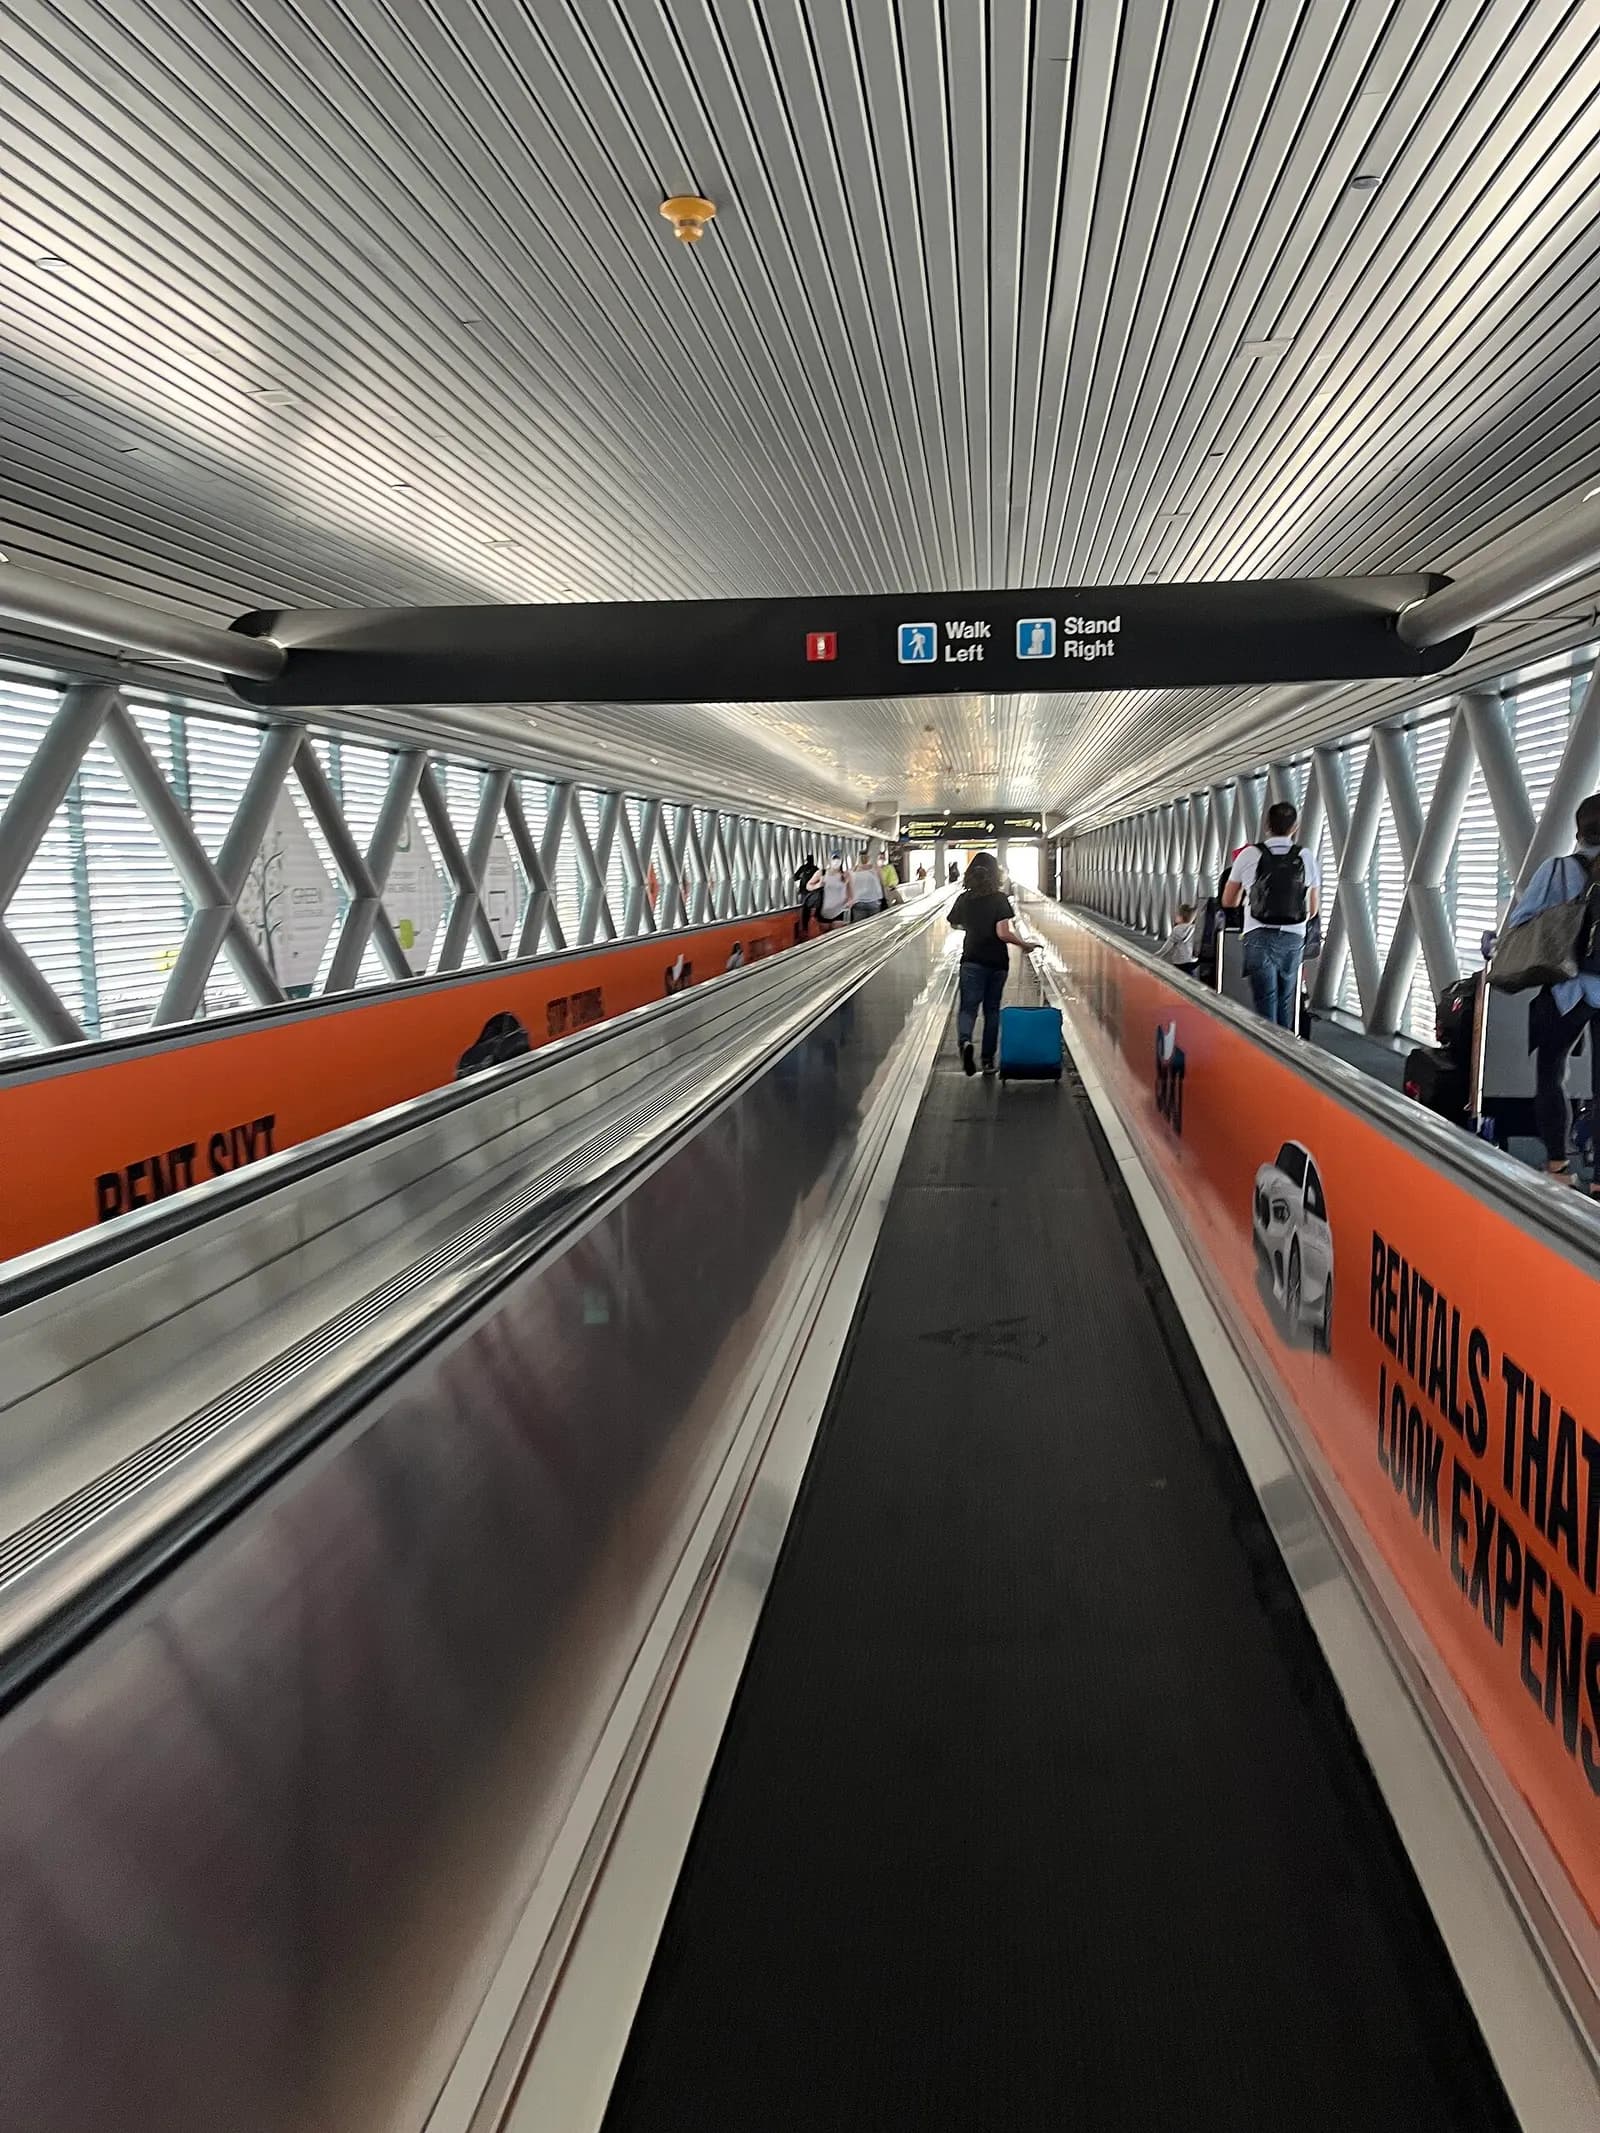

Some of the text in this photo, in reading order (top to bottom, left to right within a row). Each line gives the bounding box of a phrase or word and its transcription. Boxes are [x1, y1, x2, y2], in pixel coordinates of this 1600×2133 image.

[945, 621, 992, 640] Walk
[1063, 616, 1121, 636] Stand
[945, 645, 985, 663] Left
[1063, 639, 1115, 662] Right
[1369, 1229, 1600, 1592] RENTALS THAT
[1376, 1361, 1444, 1552] LOOK
